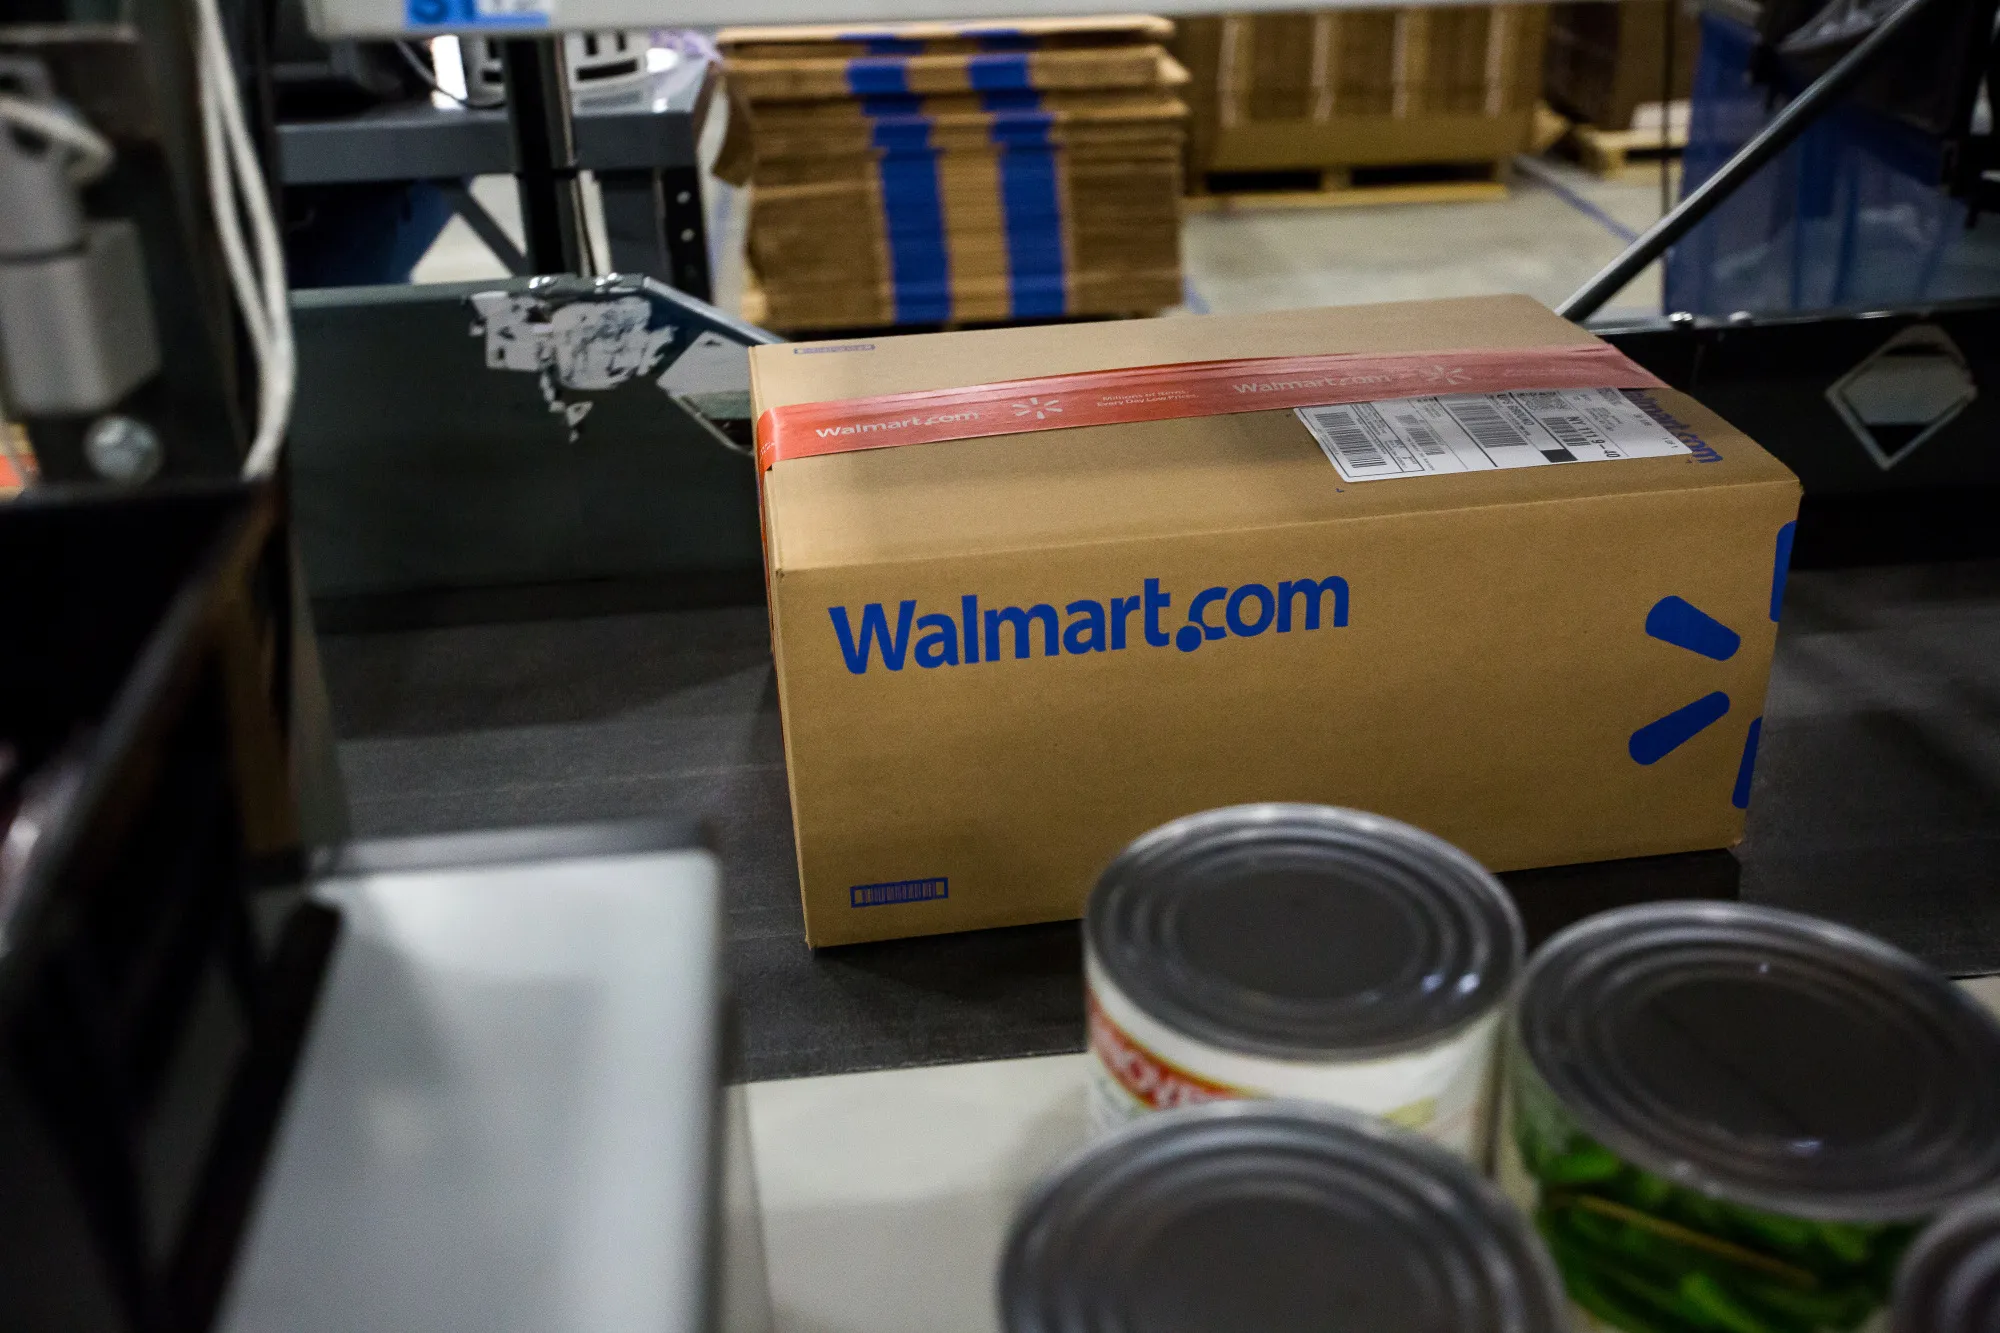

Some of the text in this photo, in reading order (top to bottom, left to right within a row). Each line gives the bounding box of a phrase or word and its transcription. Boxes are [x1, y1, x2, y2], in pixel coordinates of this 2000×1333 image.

[1233, 373, 1391, 394] Walmart.com
[1097, 400, 1124, 408] Every
[816, 410, 980, 439] Walmart.com
[1567, 416, 1587, 426] NY
[828, 575, 1349, 675] Walmart.com
